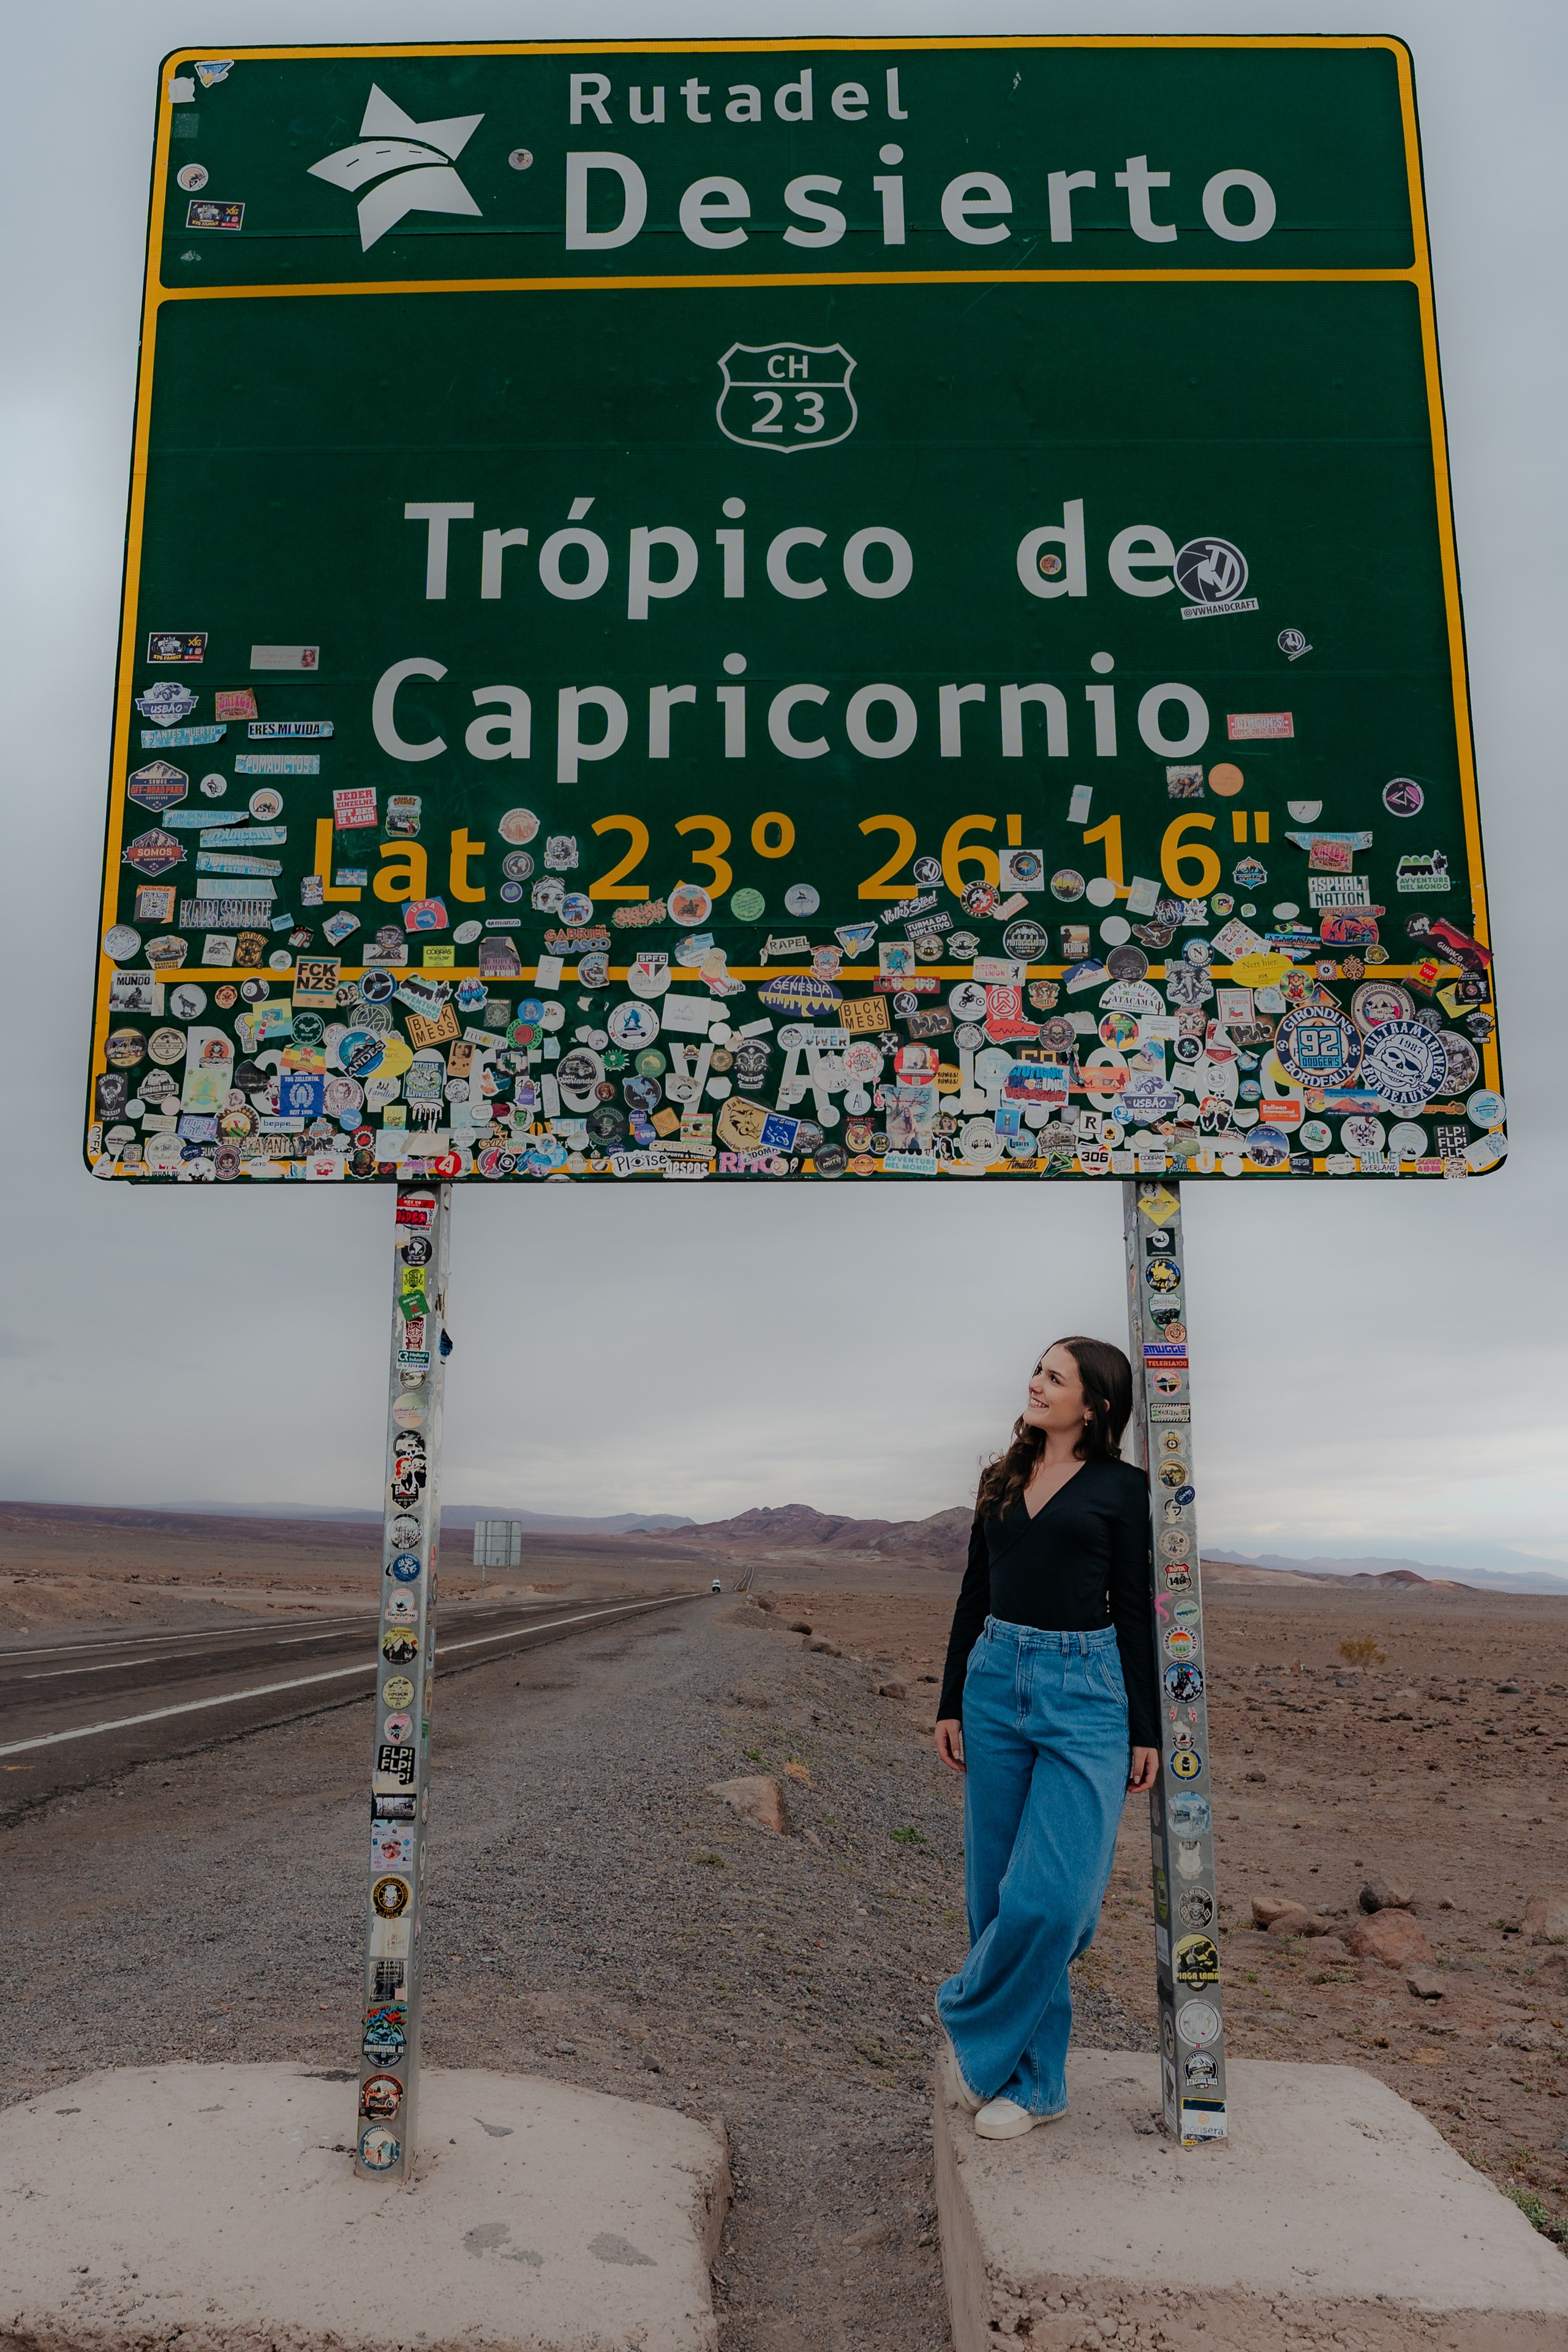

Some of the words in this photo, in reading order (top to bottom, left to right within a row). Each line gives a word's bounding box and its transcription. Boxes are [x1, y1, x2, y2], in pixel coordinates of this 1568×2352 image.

[565, 143, 1276, 250] Desierto
[767, 355, 809, 379] CH
[752, 391, 825, 434] 23
[404, 497, 913, 619] Trópico
[1017, 498, 1175, 598] de
[1183, 600, 1256, 617] @VWHANDCRAFT
[372, 652, 1210, 783] Capricornio
[156, 729, 181, 739] ANTES
[184, 727, 216, 737] MUERTO
[249, 724, 275, 735] ERES
[278, 724, 291, 734] MI
[294, 724, 320, 734] VIDA
[245, 755, 310, 773] PUMADICTOS
[336, 790, 372, 801] JEDER
[337, 809, 353, 817] IST
[351, 814, 375, 823] MANN
[314, 818, 486, 903] Lat
[1311, 877, 1367, 891] ASPHALT
[911, 891, 938, 912] Steel
[1316, 892, 1365, 905] NATION
[410, 900, 435, 913] UEFA
[907, 919, 934, 932] TURMA
[910, 921, 950, 938] SUPLETIVO
[545, 924, 610, 941] GABRIEL
[1437, 941, 1463, 961] GUANACO
[298, 963, 336, 976] FCK
[116, 976, 150, 986] MUNDO
[296, 977, 336, 990] NZS
[1072, 972, 1098, 983] INTOCHILE
[773, 981, 830, 994] GENESUR
[1118, 982, 1159, 1001] EXPEDIÇÃO
[1360, 986, 1386, 998] VIAJEROS
[1387, 986, 1404, 1000] LIBRES
[1112, 997, 1154, 1006] ATACAMA
[409, 1003, 438, 1020] MONDO
[844, 1014, 884, 1029] MESS
[1283, 1007, 1355, 1035] GIRONDINS
[416, 1023, 455, 1043] MESS
[805, 1036, 846, 1046] VIVER
[1300, 1030, 1339, 1056] 92
[1398, 1038, 1423, 1054] 1987
[349, 1042, 384, 1076] ANDES
[1365, 1022, 1445, 1083] ULTRAMARINES
[1302, 1057, 1340, 1066] DODGER'S
[737, 1073, 764, 1082] CUSTOM
[1283, 1061, 1354, 1087] BORDEAUX
[1363, 1066, 1430, 1103] BORDEAUX
[1133, 1097, 1166, 1107] USBÃO
[184, 1118, 214, 1129] WORST
[263, 1119, 293, 1128] beppe
[1086, 1116, 1097, 1129] R
[182, 1127, 213, 1137] ADVICE
[1438, 1126, 1465, 1137] FLP!
[1009, 1138, 1029, 1148] Lugares
[1439, 1137, 1467, 1147] FLP!
[886, 1156, 935, 1166] AVVENTURE
[1082, 1152, 1108, 1162] 306
[1360, 1151, 1397, 1164] CHILE
[902, 1163, 935, 1172] MONDO
[382, 1747, 413, 1759] FLP!
[381, 1759, 412, 1771] FLP!
[1176, 1972, 1197, 1980] PINGA
[1199, 1972, 1218, 1980] LAMA
[1186, 2078, 1205, 2086] ATACAMA
[1183, 2122, 1223, 2136] bonserá
